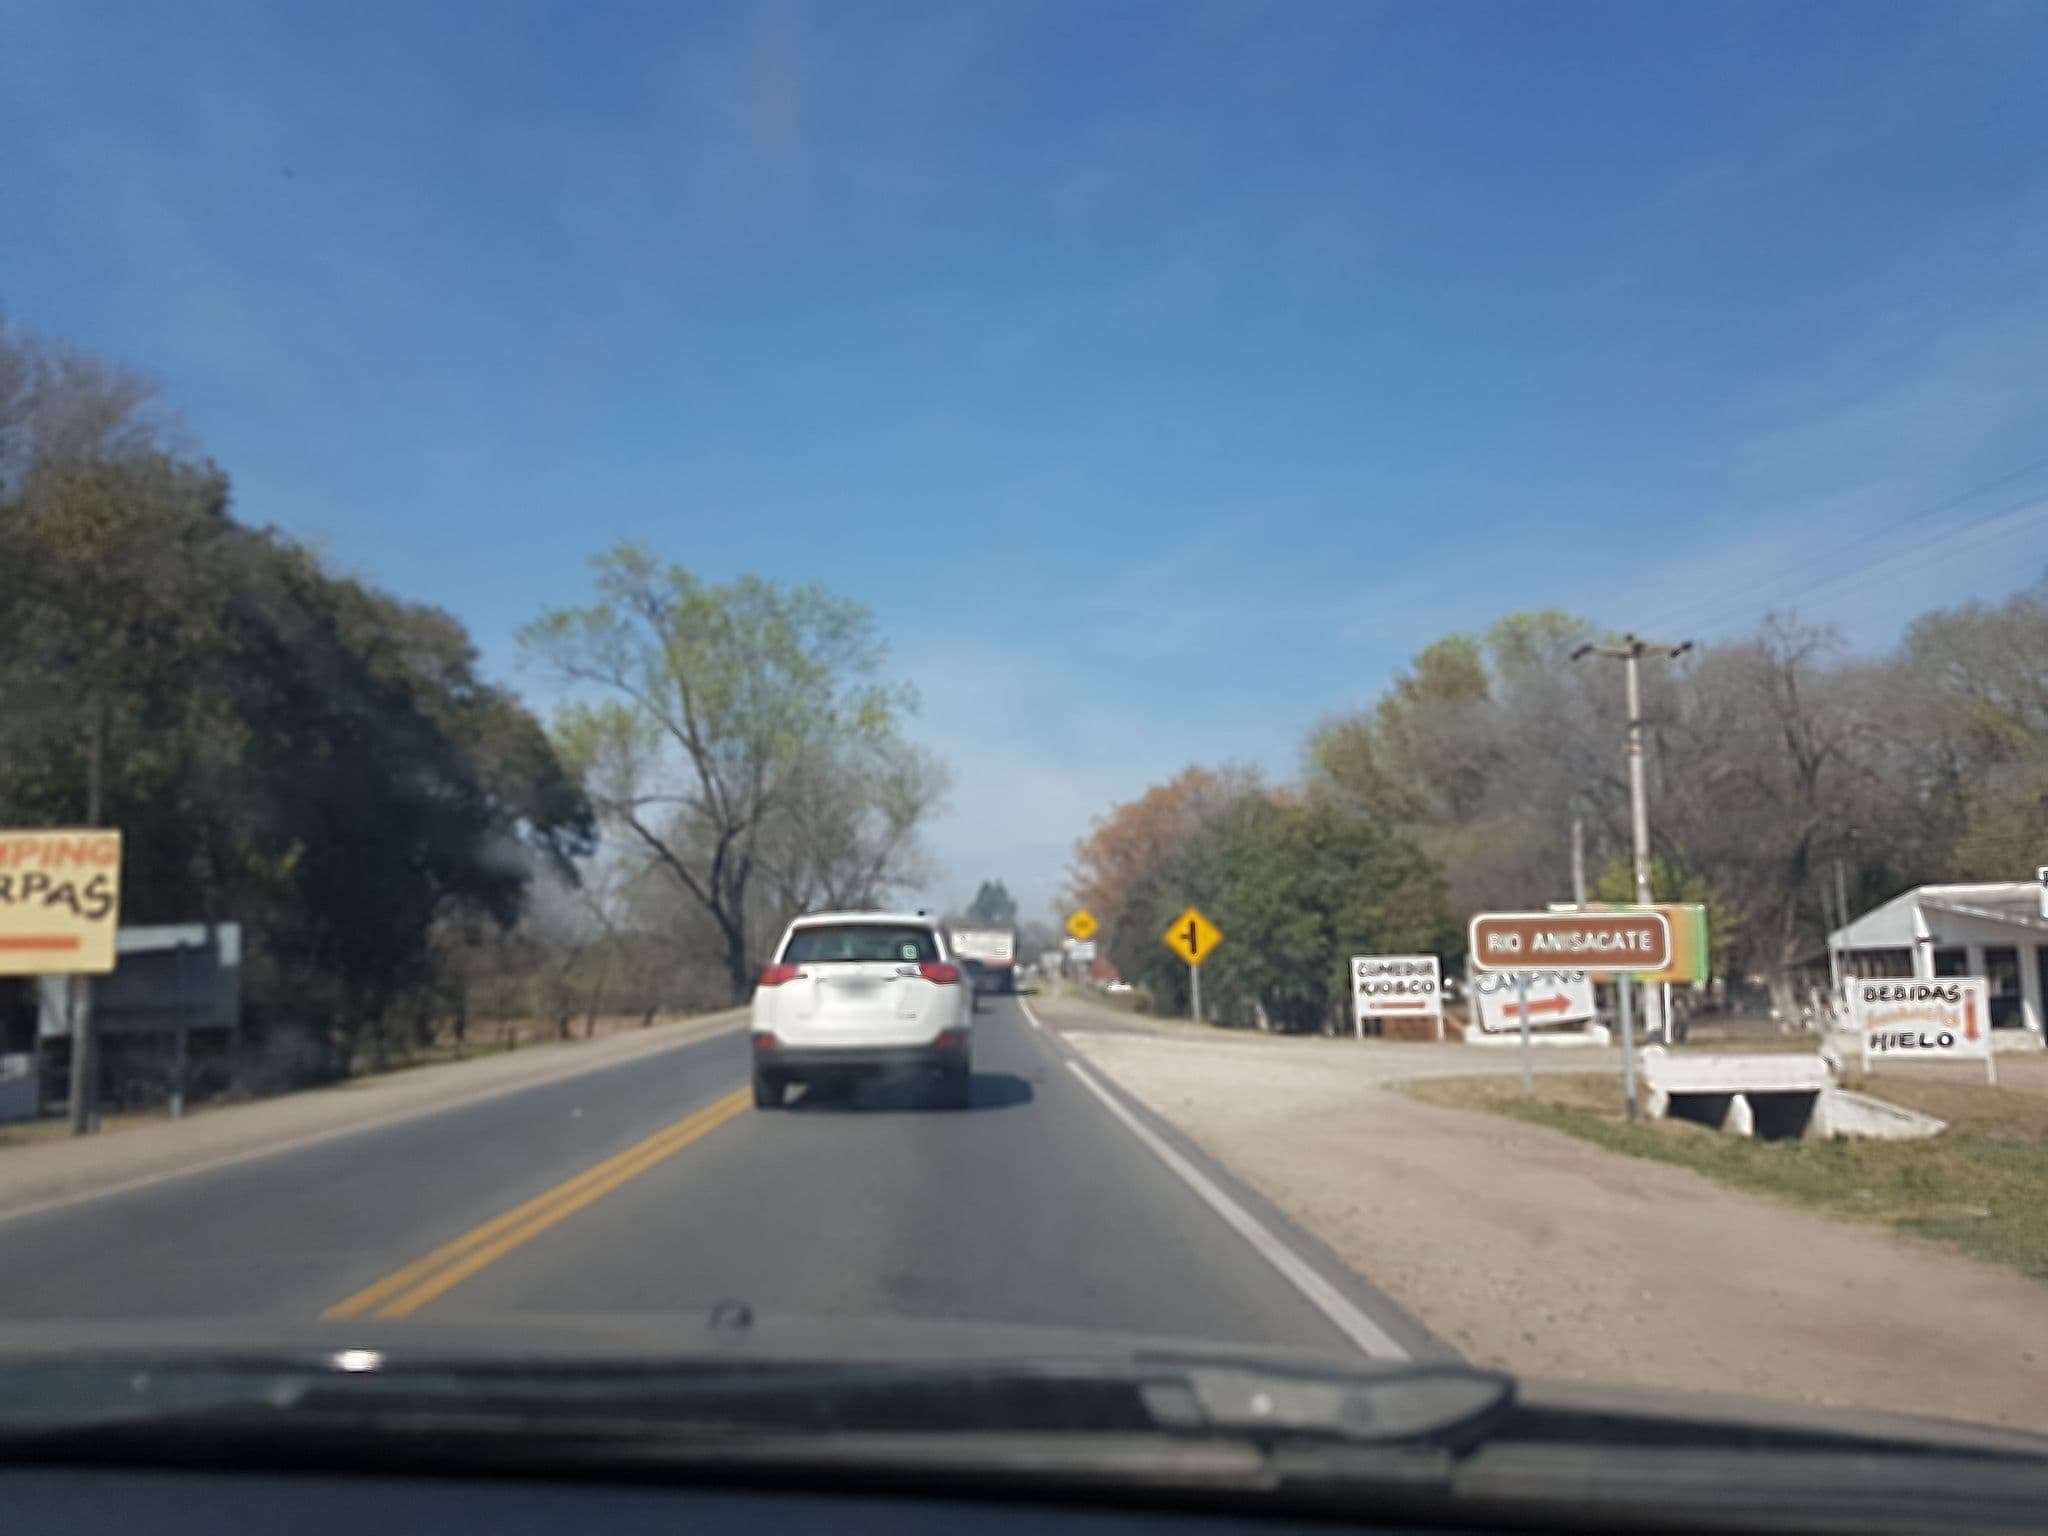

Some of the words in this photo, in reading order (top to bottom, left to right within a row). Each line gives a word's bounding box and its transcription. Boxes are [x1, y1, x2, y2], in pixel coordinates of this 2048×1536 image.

[1532, 929, 1655, 952] ANISACATE
[1863, 984, 1962, 1004] BEBIDAS
[1869, 1031, 1955, 1052] HIELO
